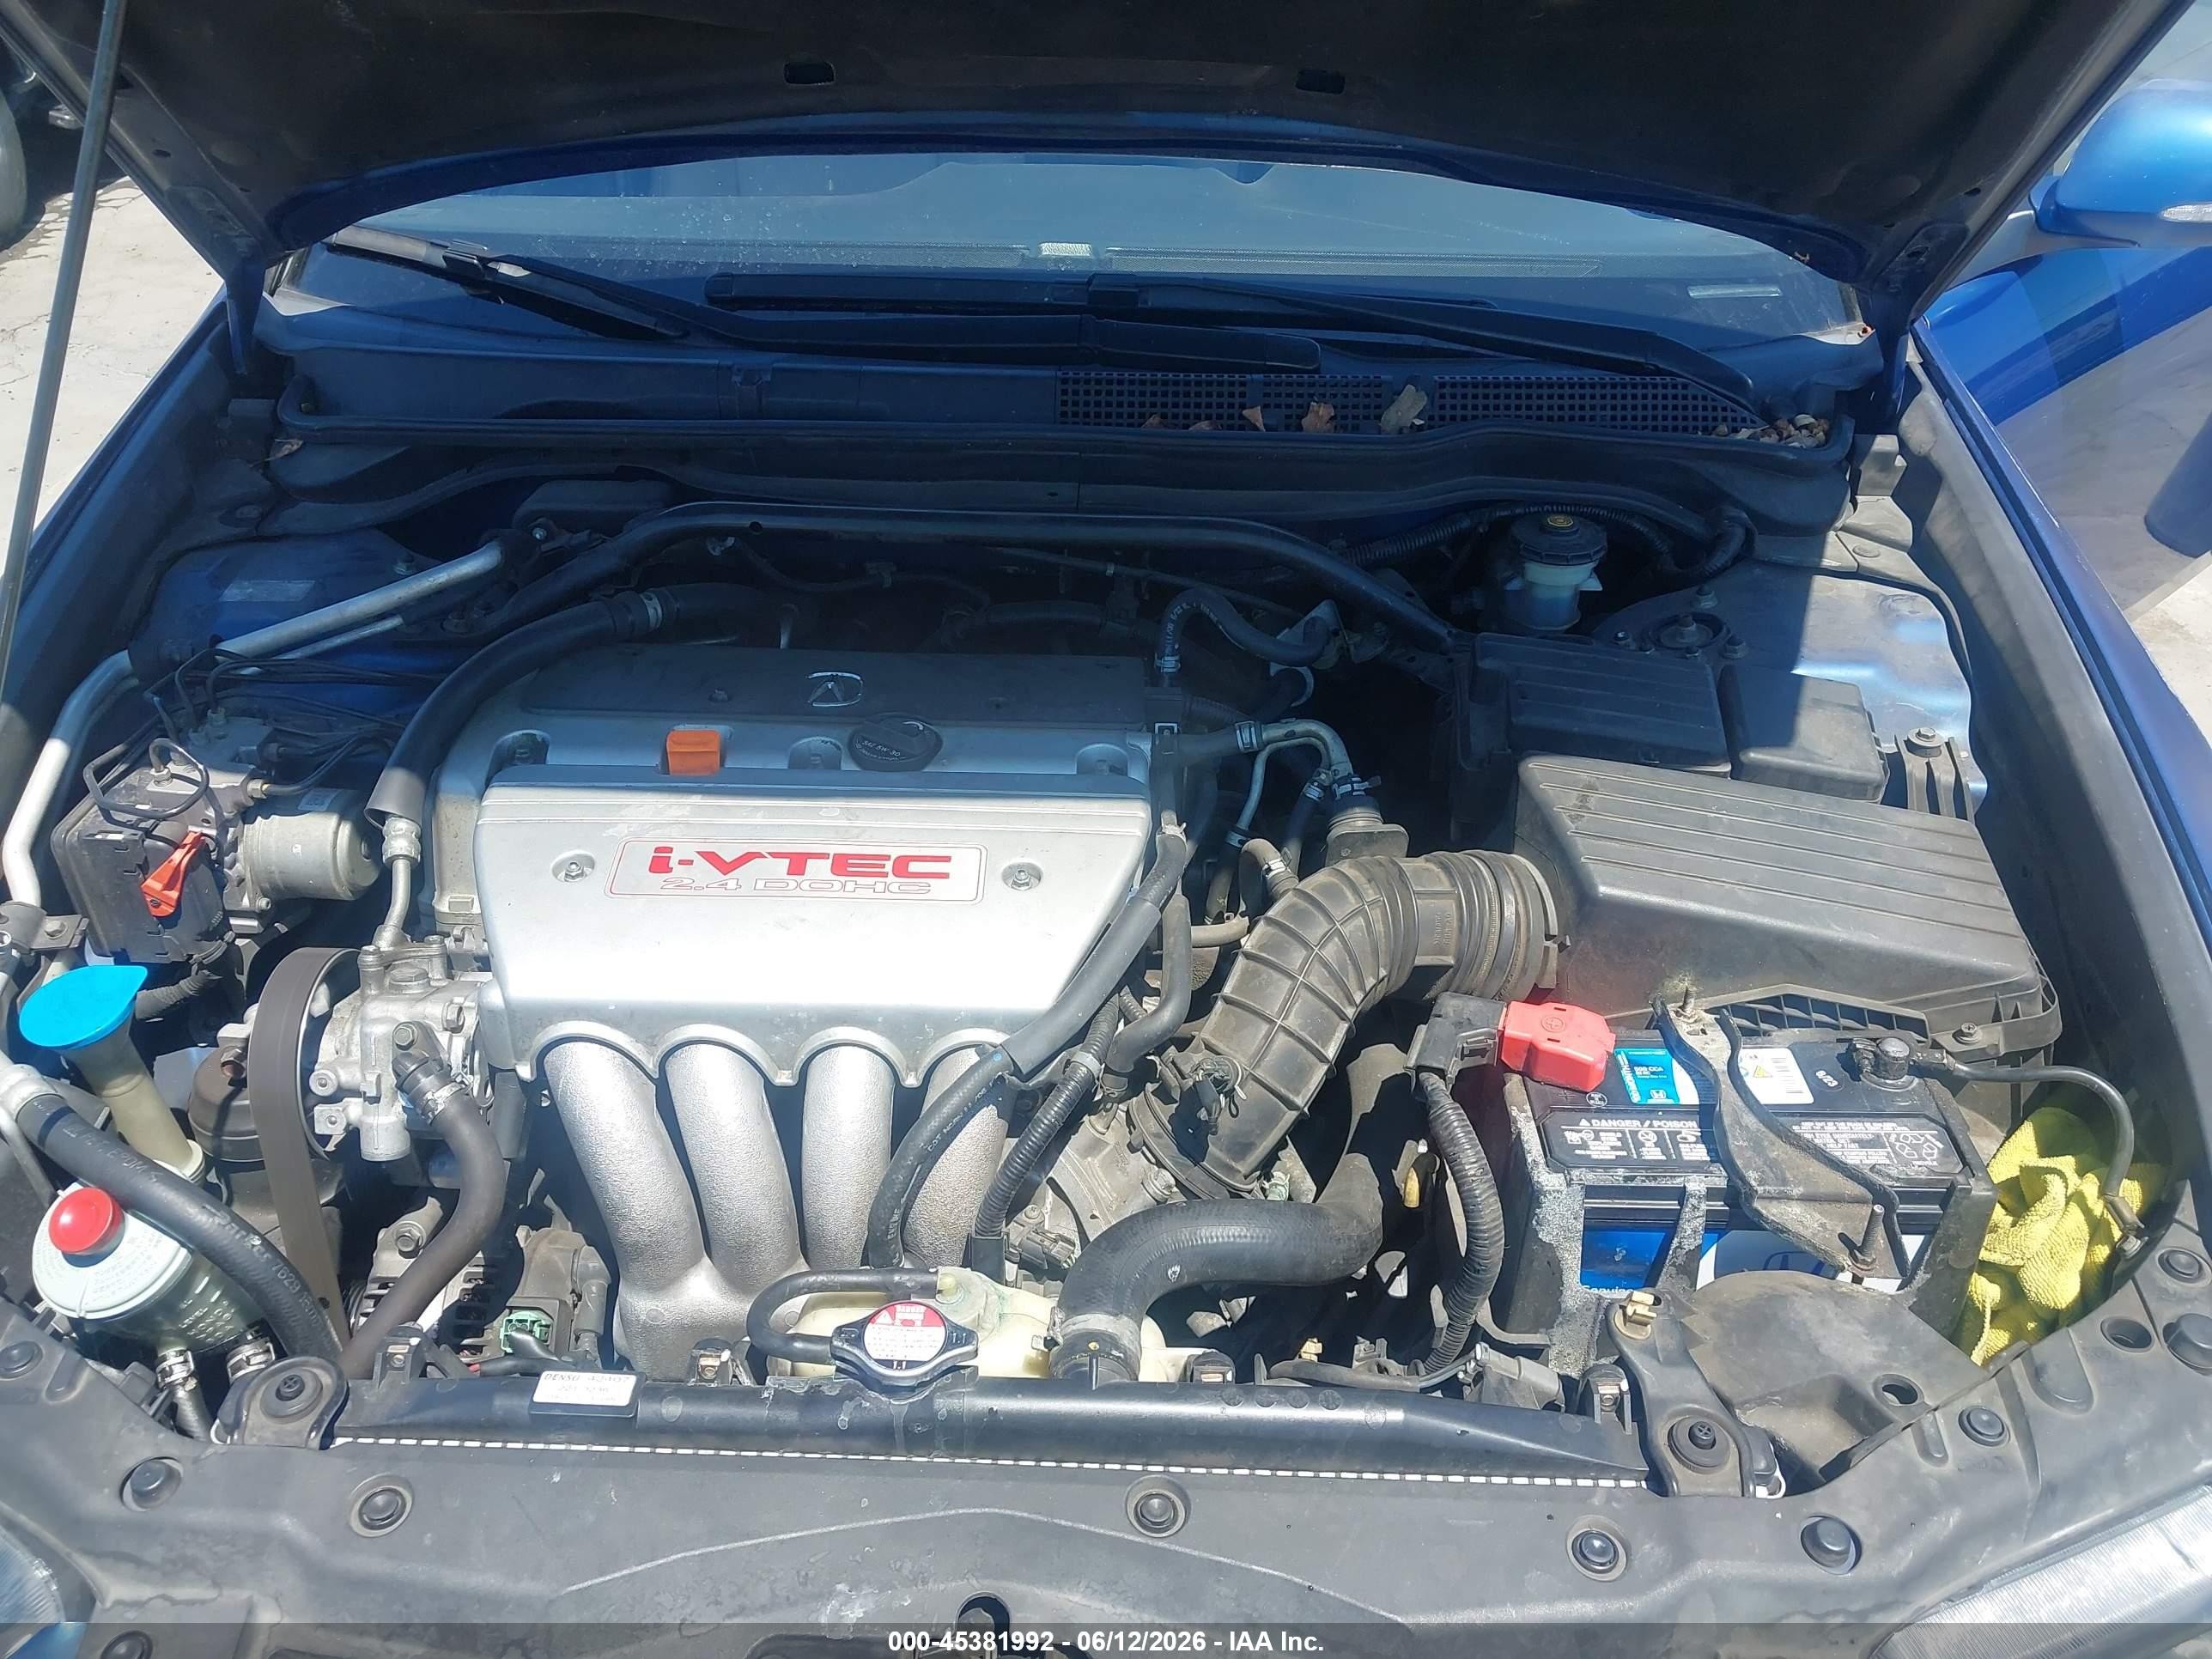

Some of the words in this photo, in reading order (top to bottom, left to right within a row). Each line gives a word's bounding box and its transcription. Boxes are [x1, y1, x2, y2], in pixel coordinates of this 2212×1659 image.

[648, 846, 952, 878] i-VTEC
[659, 877, 743, 891] 2.4
[753, 878, 933, 894] DOHC
[1653, 1120, 1698, 1128] POISON
[544, 1373, 580, 1382] DENSO
